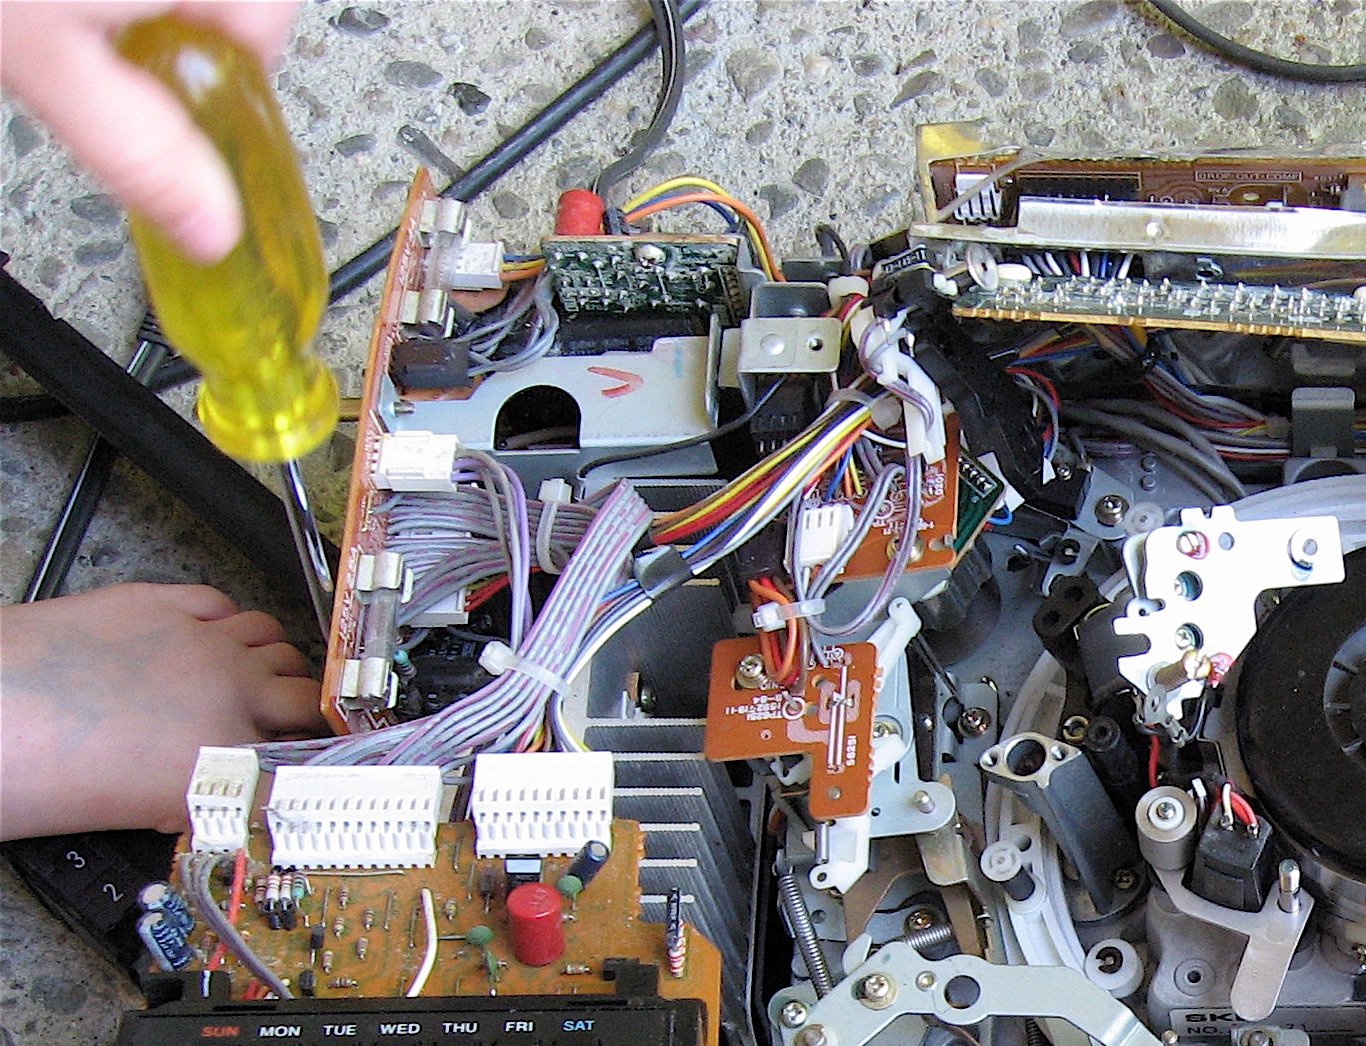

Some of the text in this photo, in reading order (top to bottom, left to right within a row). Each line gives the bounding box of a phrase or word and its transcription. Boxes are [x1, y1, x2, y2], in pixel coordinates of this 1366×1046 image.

[65, 850, 86, 869] 3
[103, 883, 124, 902] 2
[202, 1025, 241, 1038] SUN
[258, 1025, 301, 1038] MON
[323, 1024, 358, 1036] TUE
[380, 1023, 421, 1035] WED
[442, 1022, 478, 1034] THU
[505, 1021, 534, 1032] FRI
[562, 1020, 596, 1032] SAT
